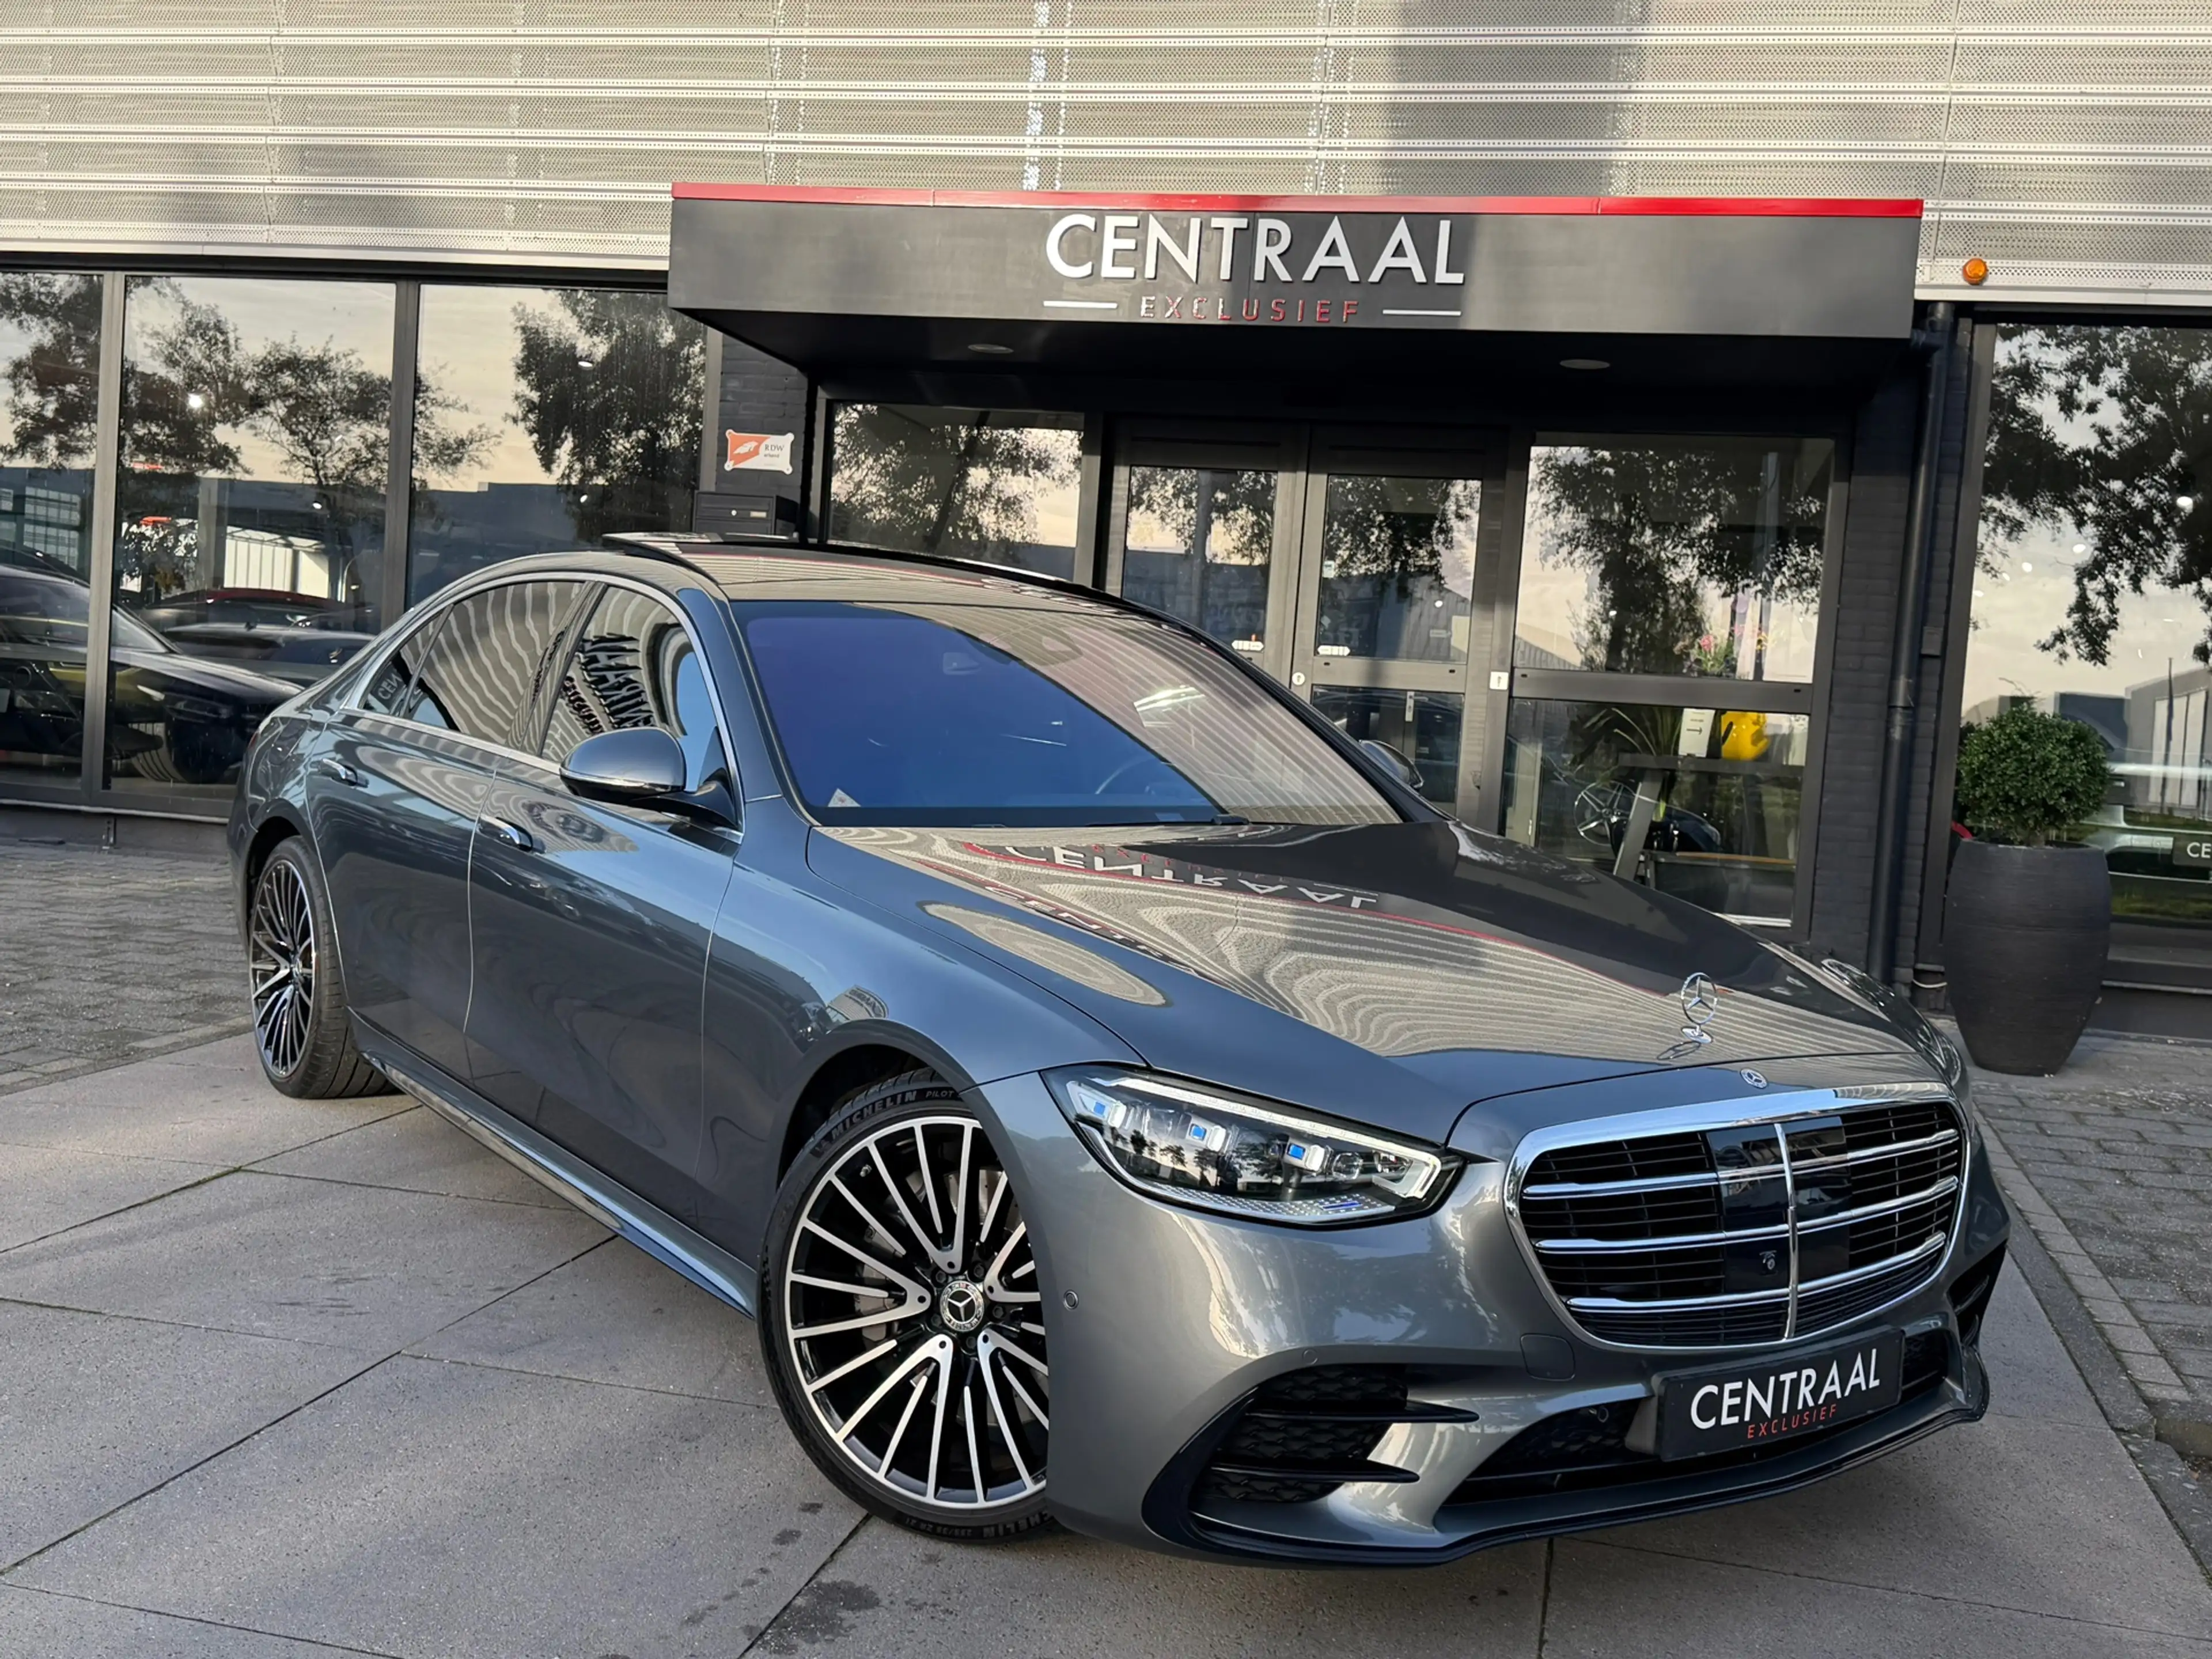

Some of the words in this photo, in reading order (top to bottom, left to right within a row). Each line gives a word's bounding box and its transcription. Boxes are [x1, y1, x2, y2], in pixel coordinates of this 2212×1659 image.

[1046, 214, 1464, 284] CENTRAAL
[1141, 296, 1359, 323] EXCLUSIEF
[832, 1090, 917, 1138] MICHELIN
[925, 1090, 954, 1098] PILOT
[1690, 1348, 1880, 1429] CENTRAAL
[1747, 1403, 1837, 1439] EXCLUSIEF
